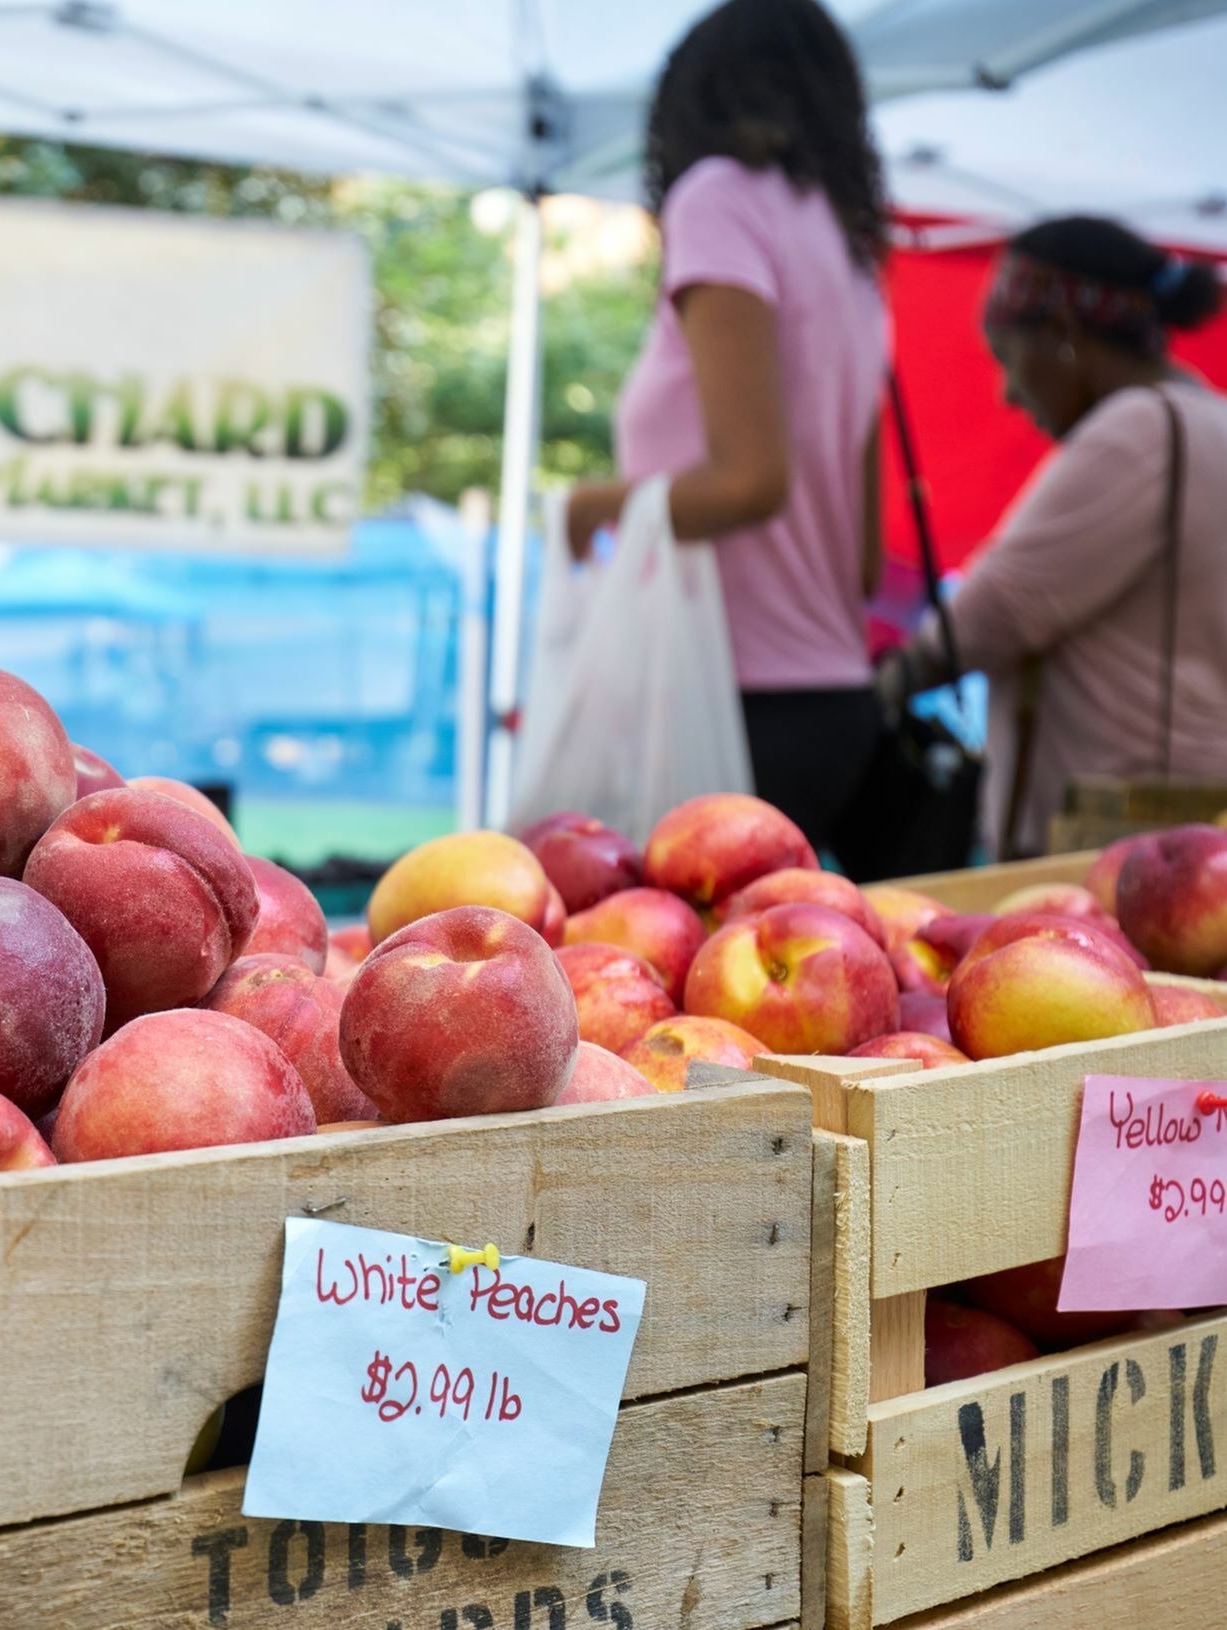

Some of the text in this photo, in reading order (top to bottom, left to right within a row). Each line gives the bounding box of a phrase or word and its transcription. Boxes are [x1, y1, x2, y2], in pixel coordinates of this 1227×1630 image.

[1109, 1090, 1203, 1149] Yellow
[1148, 1173, 1227, 1223] $2.99
[315, 1248, 622, 1333] White Peaches
[361, 1350, 522, 1422] $2.99 lb
[957, 1334, 1220, 1563] MICK
[192, 1519, 509, 1626] TOIG
